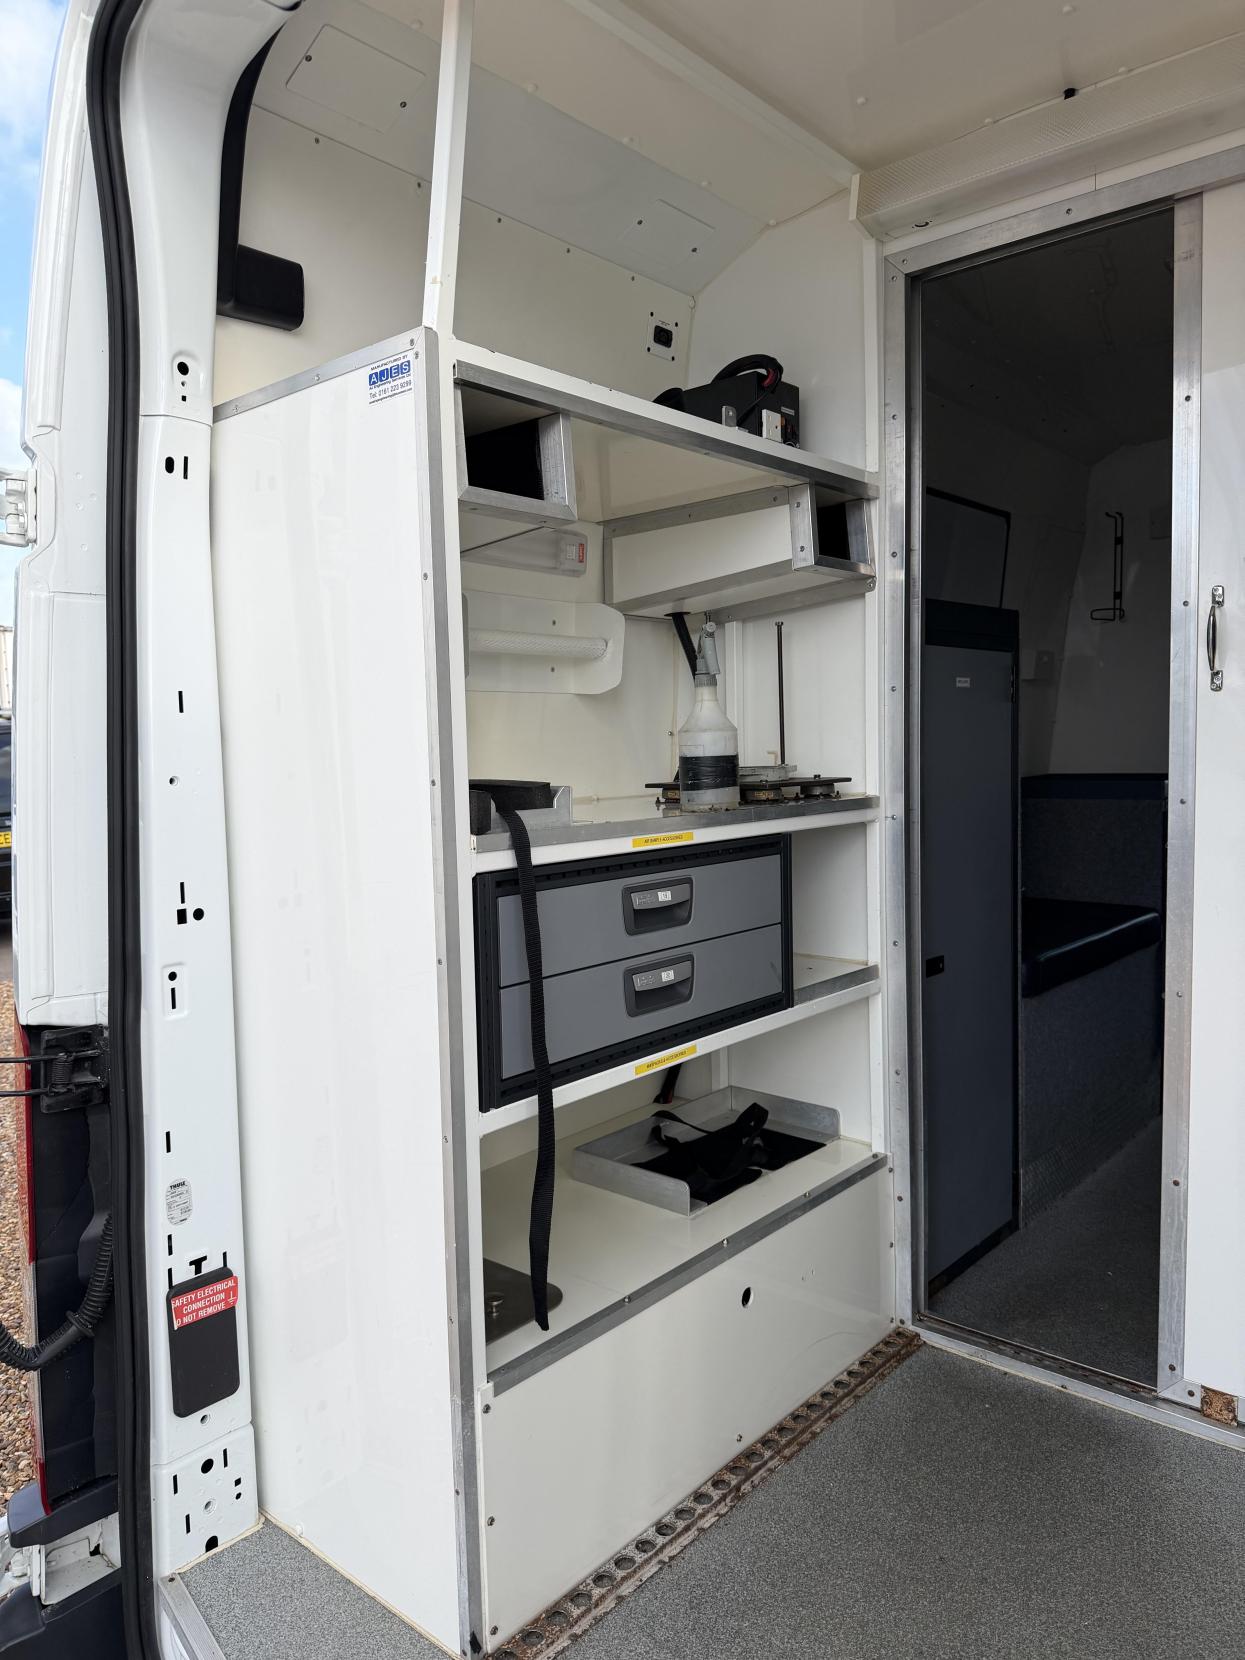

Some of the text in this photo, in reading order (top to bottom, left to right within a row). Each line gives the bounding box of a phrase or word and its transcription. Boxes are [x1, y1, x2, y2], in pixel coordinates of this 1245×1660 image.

[369, 360, 410, 386] AJES
[169, 1180, 186, 1190] THULE
[197, 1279, 236, 1299] ELECTRICAL
[182, 1292, 225, 1314] CONNECTION
[182, 1312, 197, 1324] NOT
[198, 1301, 226, 1318] REMOVE
